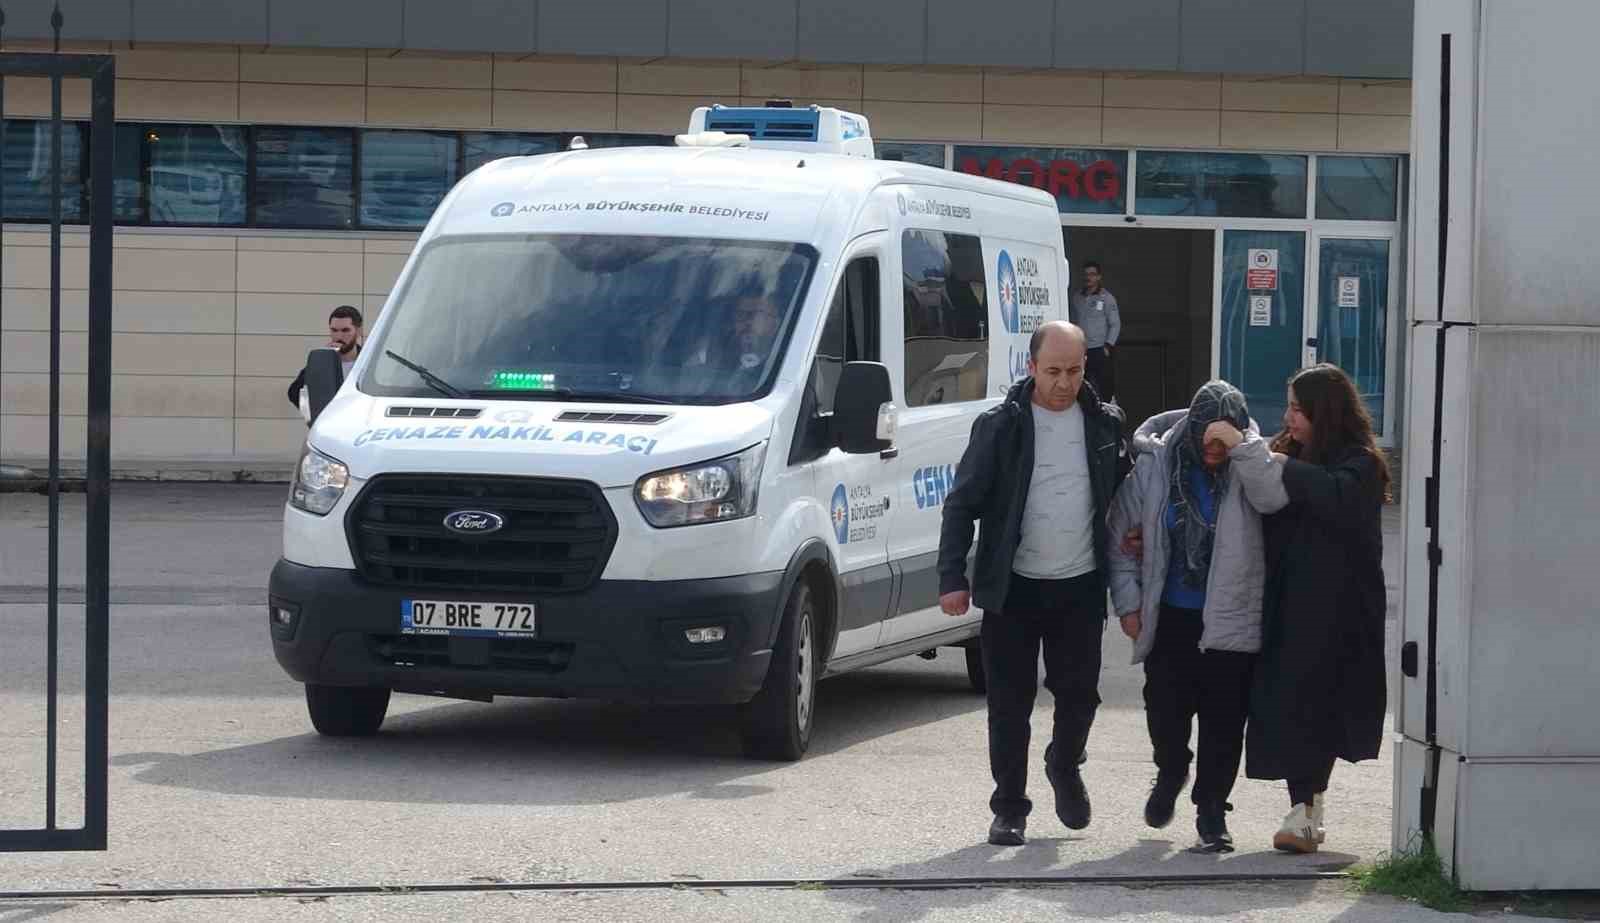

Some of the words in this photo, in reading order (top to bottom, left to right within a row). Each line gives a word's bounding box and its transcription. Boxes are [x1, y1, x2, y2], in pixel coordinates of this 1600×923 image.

[518, 202, 581, 215] ANTALYA
[585, 201, 684, 214] BÜYÜKŞEHİR
[689, 206, 769, 222] BELEDİYESİ
[469, 424, 554, 441] NAKİL
[455, 514, 488, 528] Ford
[413, 603, 436, 625] 07
[445, 603, 482, 627] BRE
[494, 606, 532, 629] 772
